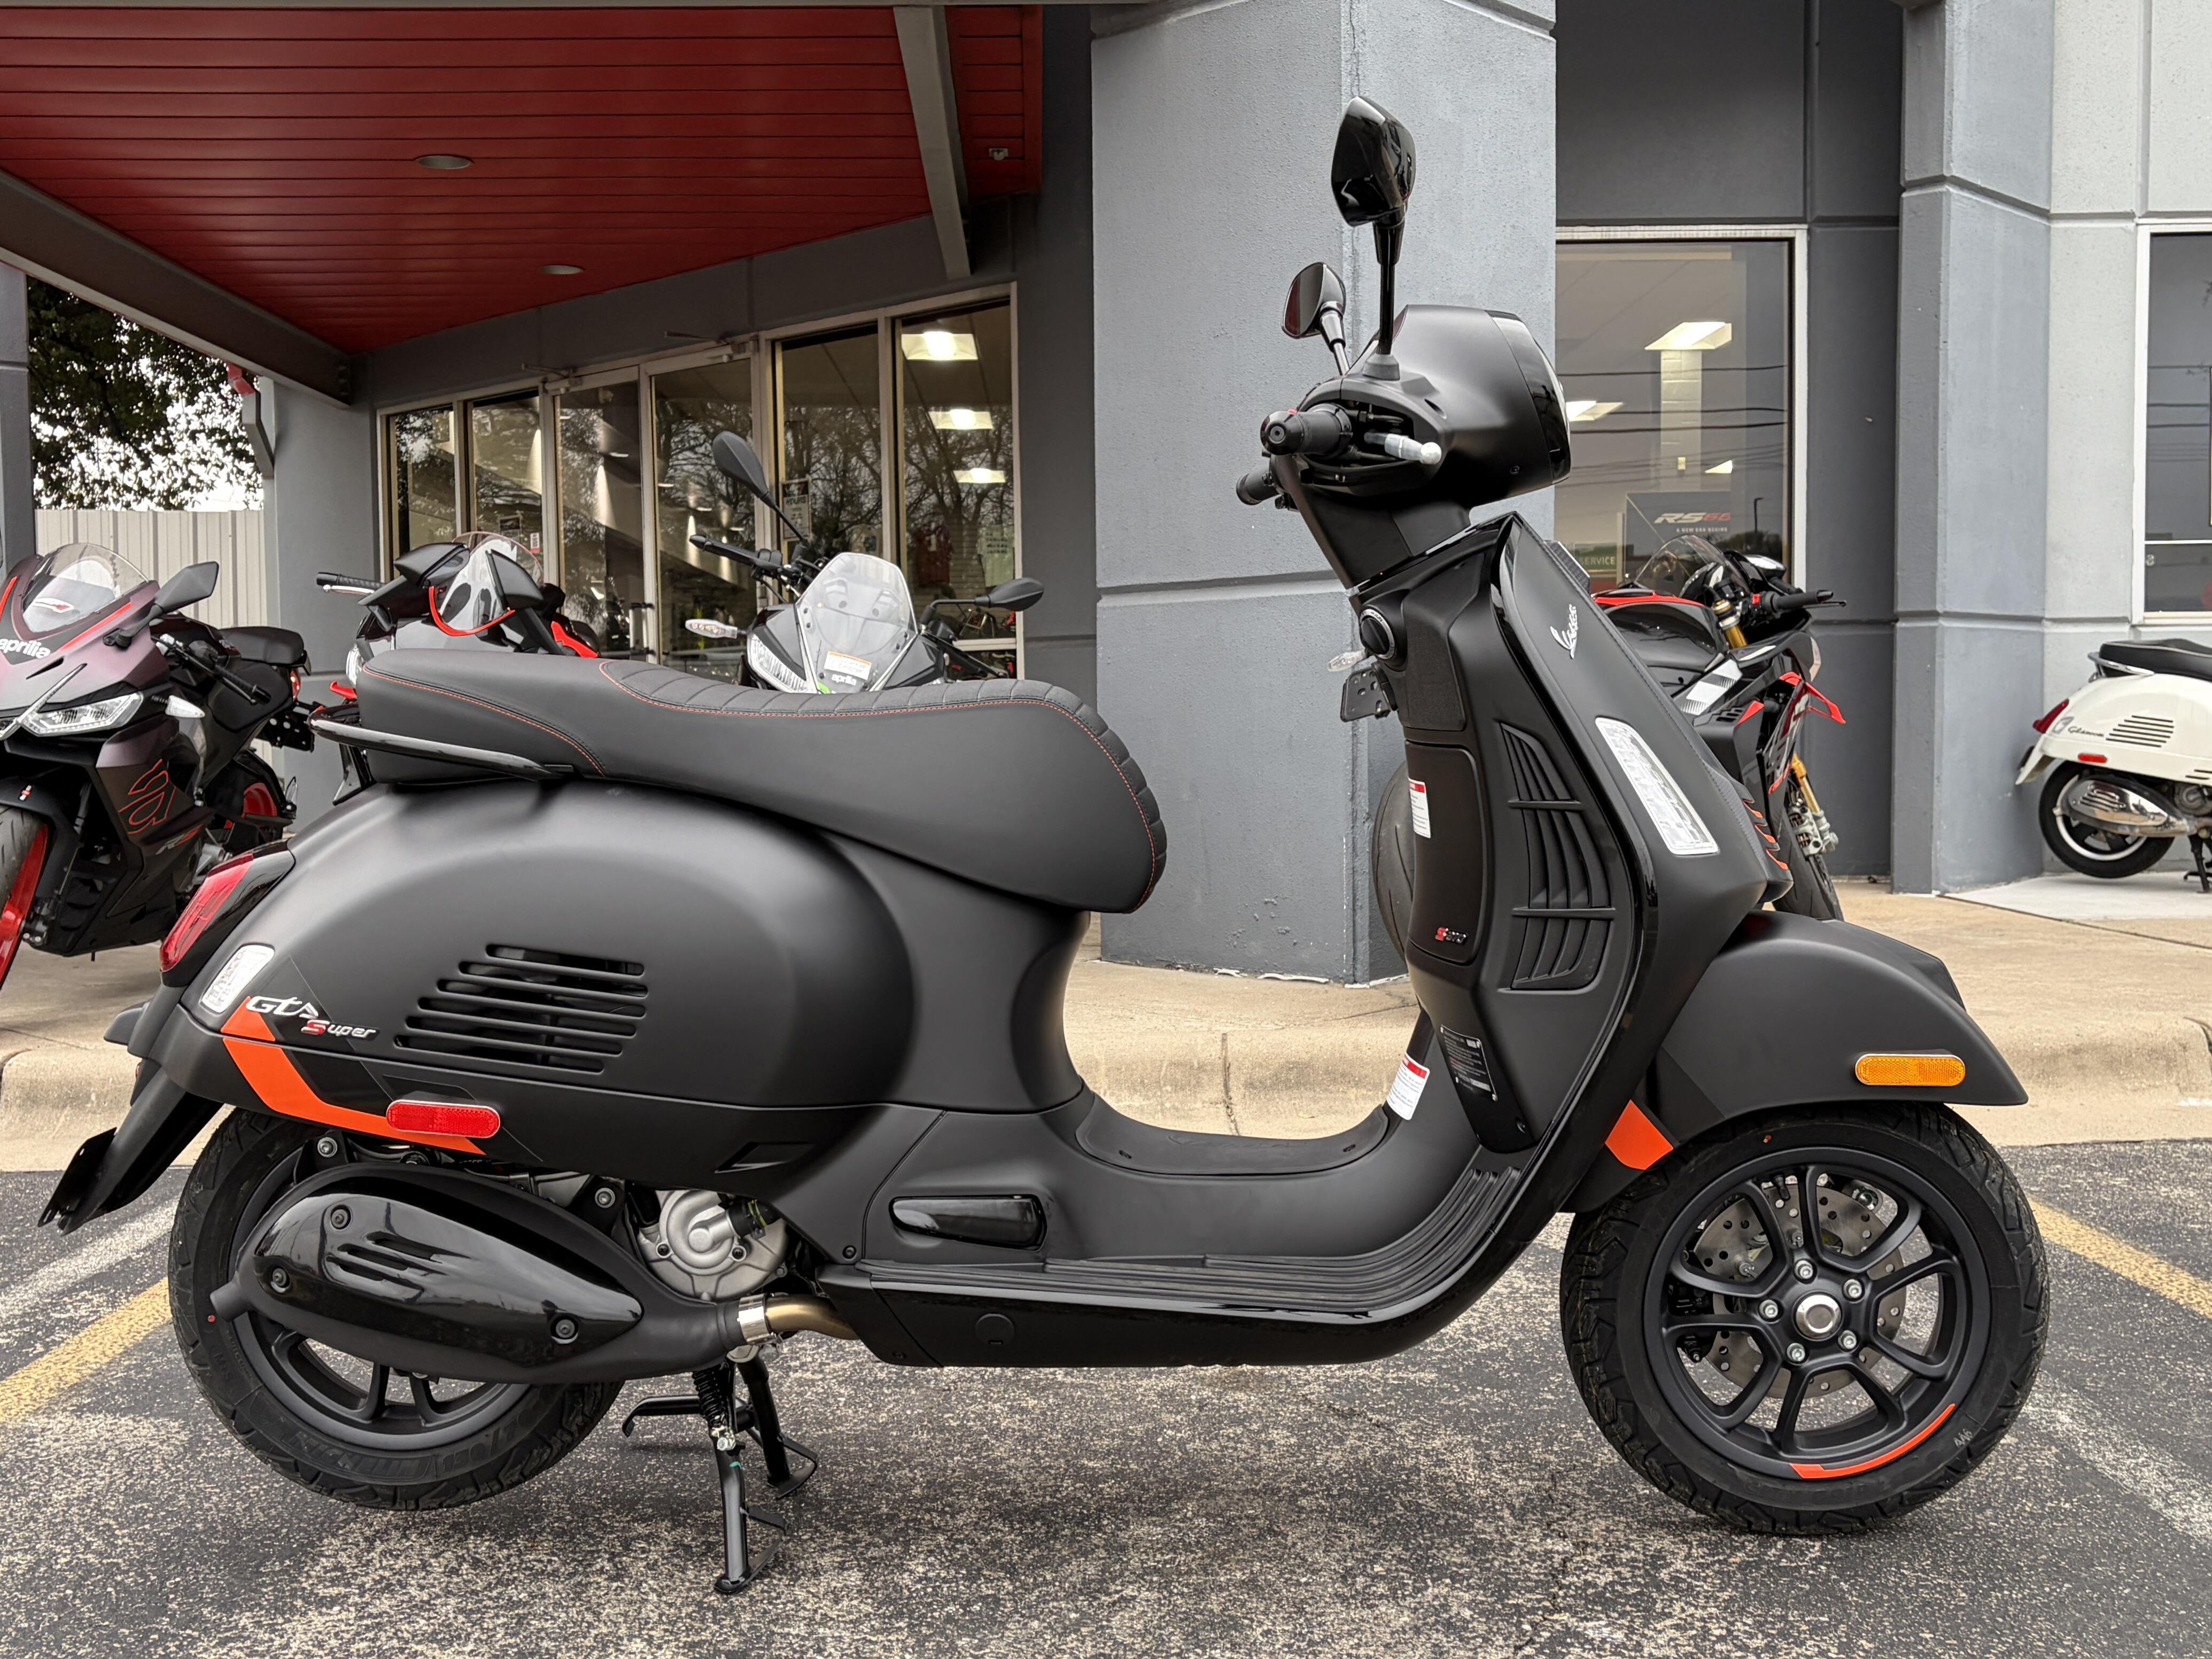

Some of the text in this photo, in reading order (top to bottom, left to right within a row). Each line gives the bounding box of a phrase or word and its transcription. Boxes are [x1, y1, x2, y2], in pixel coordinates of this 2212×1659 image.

[0, 638, 51, 659] aprilia
[831, 674, 857, 686] aprilia
[301, 1019, 377, 1036] Super
